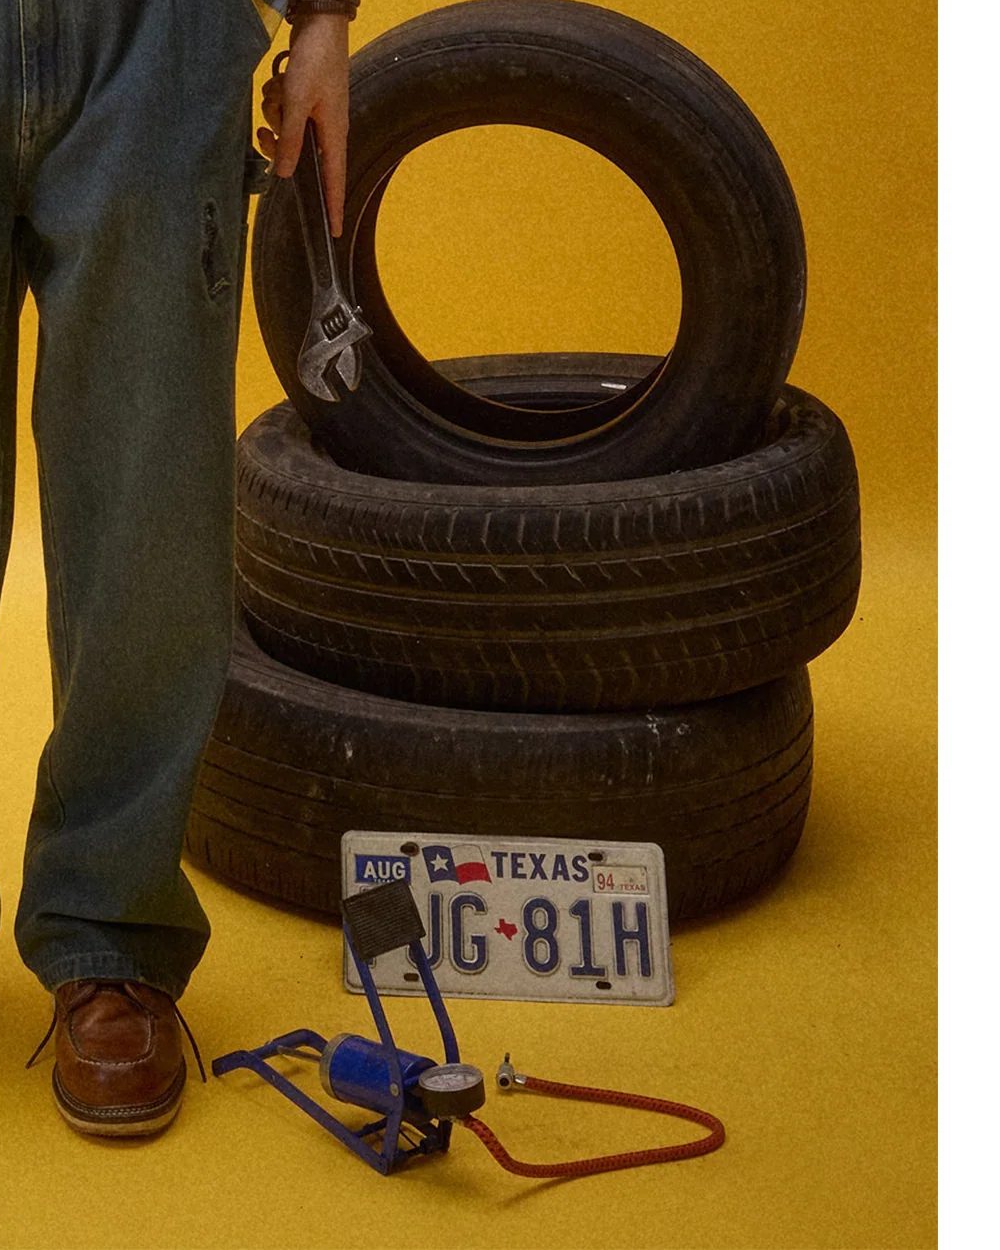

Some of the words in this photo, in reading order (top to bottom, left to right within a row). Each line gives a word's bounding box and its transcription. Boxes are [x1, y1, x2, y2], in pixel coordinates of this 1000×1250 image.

[363, 860, 406, 880] AUG
[491, 851, 589, 883] TEXAS
[596, 872, 615, 891] 94
[619, 883, 646, 891] TEXAS
